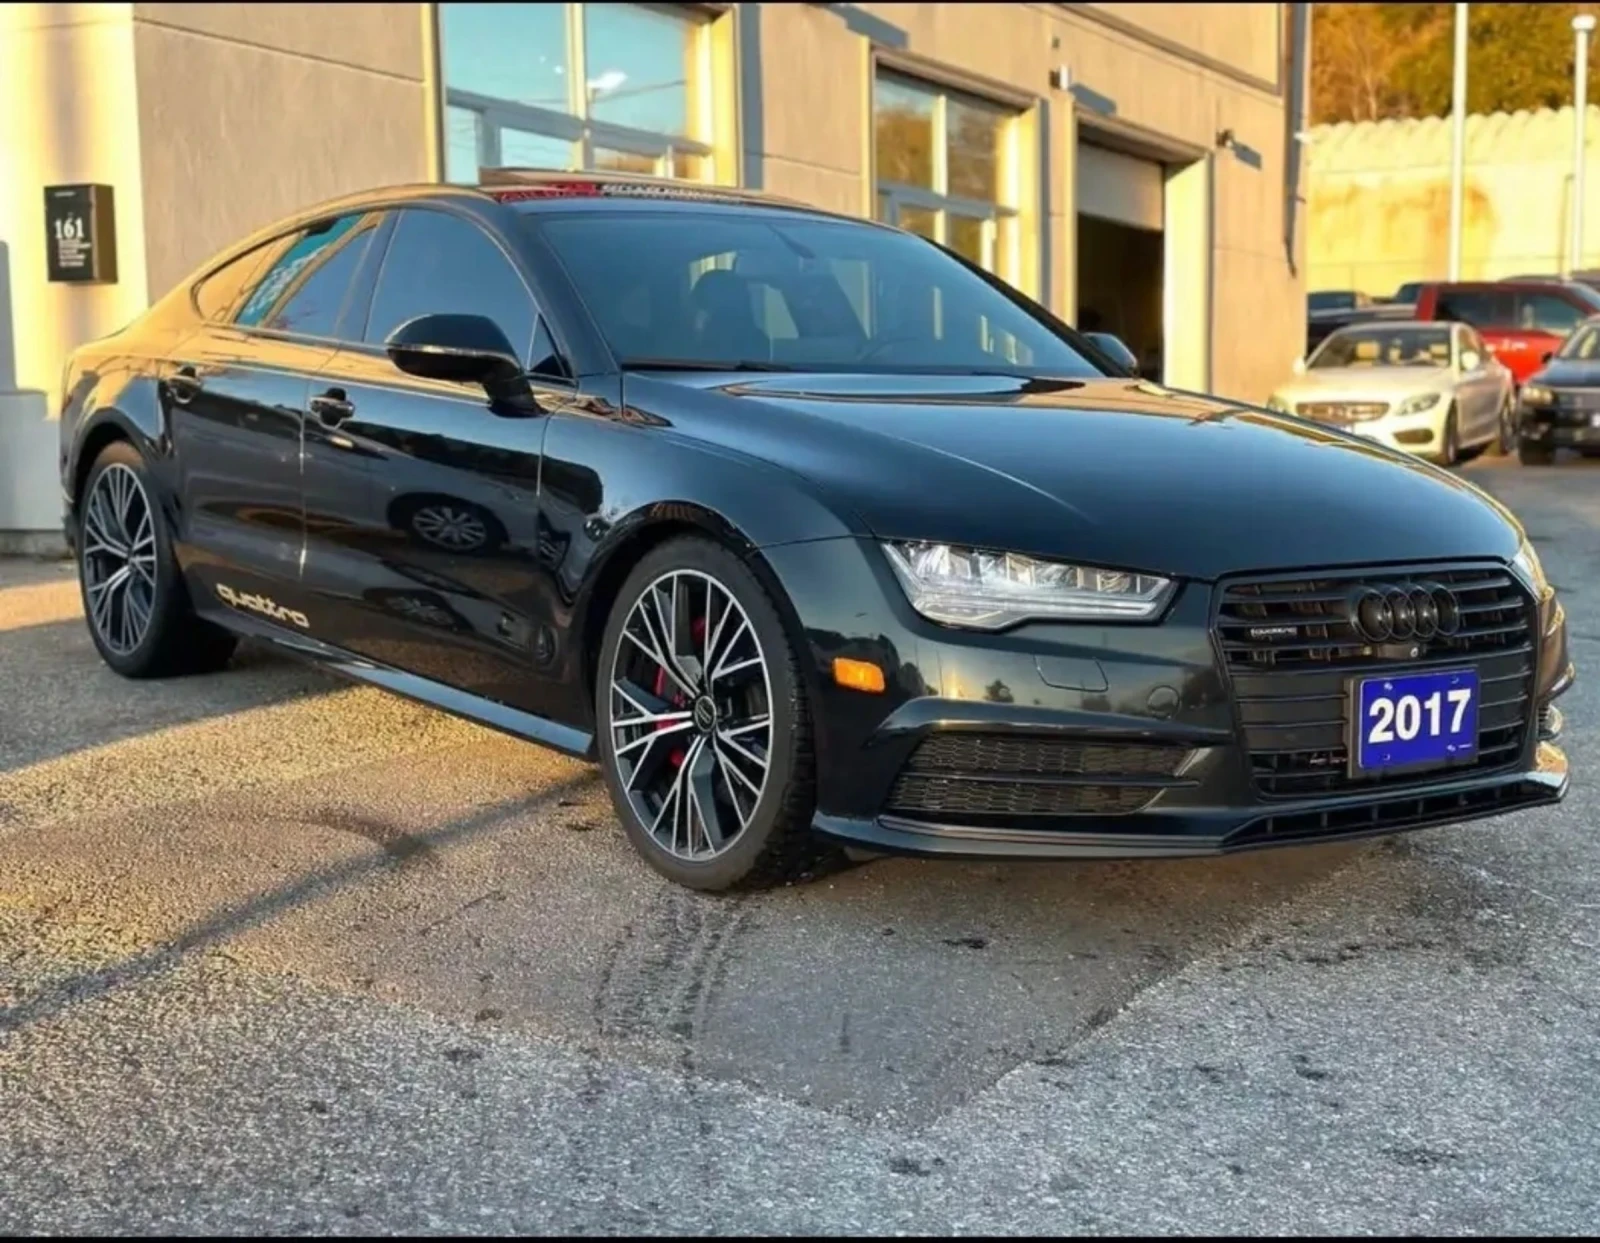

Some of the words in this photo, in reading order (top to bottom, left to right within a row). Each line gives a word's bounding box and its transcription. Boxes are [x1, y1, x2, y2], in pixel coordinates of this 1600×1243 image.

[55, 217, 84, 239] 161
[216, 583, 310, 628] quattro
[1368, 688, 1471, 744] 2017
